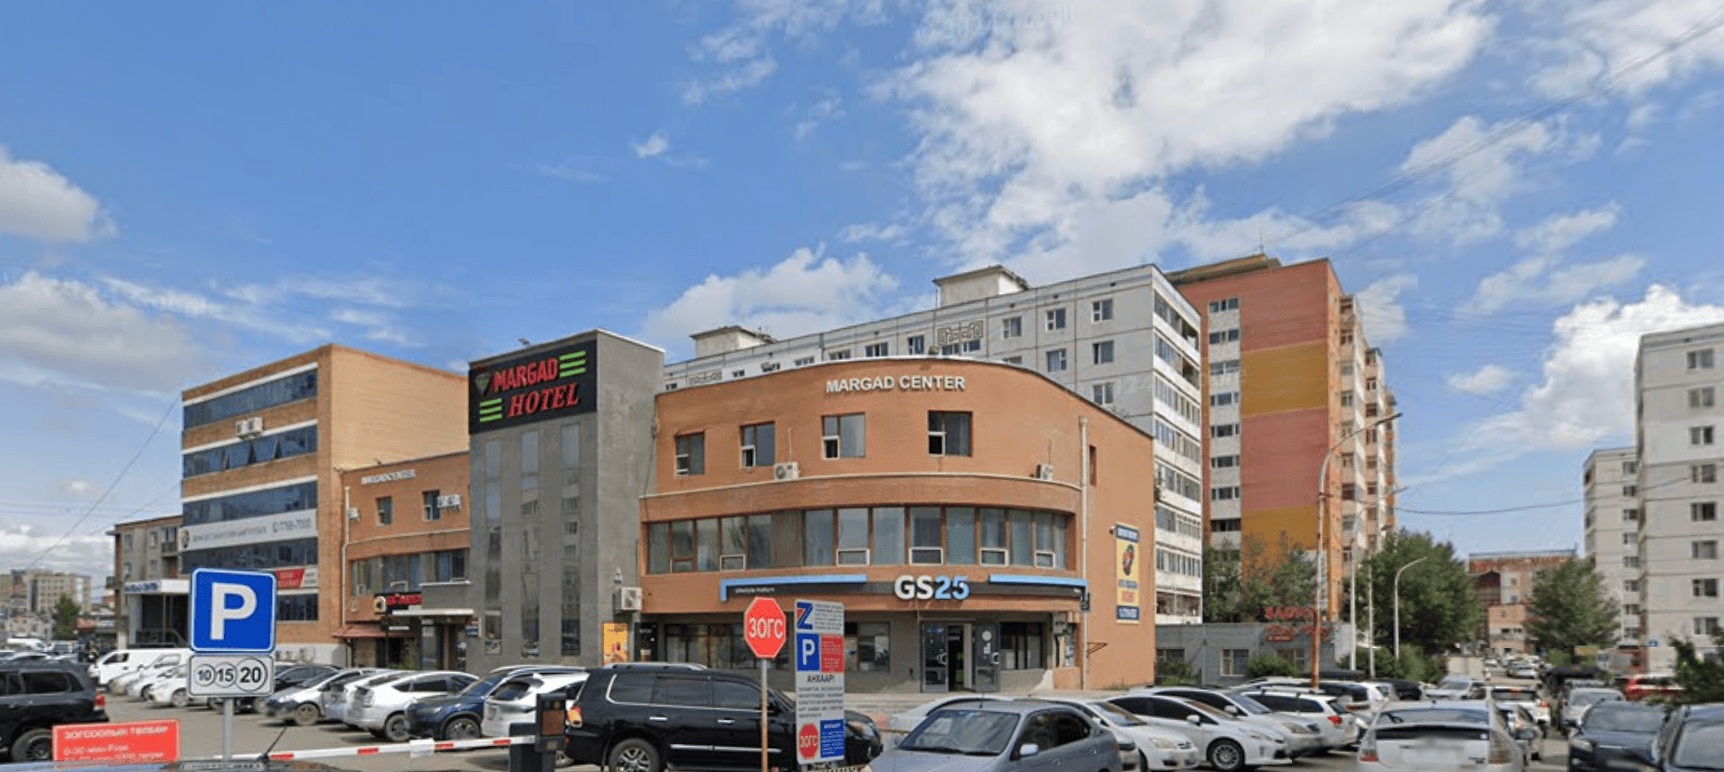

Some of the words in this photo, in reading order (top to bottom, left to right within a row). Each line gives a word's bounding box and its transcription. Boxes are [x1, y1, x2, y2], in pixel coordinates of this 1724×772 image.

[492, 357, 558, 393] MARGAD
[826, 376, 895, 393] MARGAD
[899, 375, 966, 391] CENTER
[508, 381, 580, 418] HOTEL
[894, 574, 970, 602] GS25
[209, 581, 258, 641] P
[748, 617, 784, 639] ЗОГС
[802, 638, 816, 666] P
[197, 669, 212, 682] 10
[218, 668, 234, 682] 15
[240, 666, 262, 683] 20
